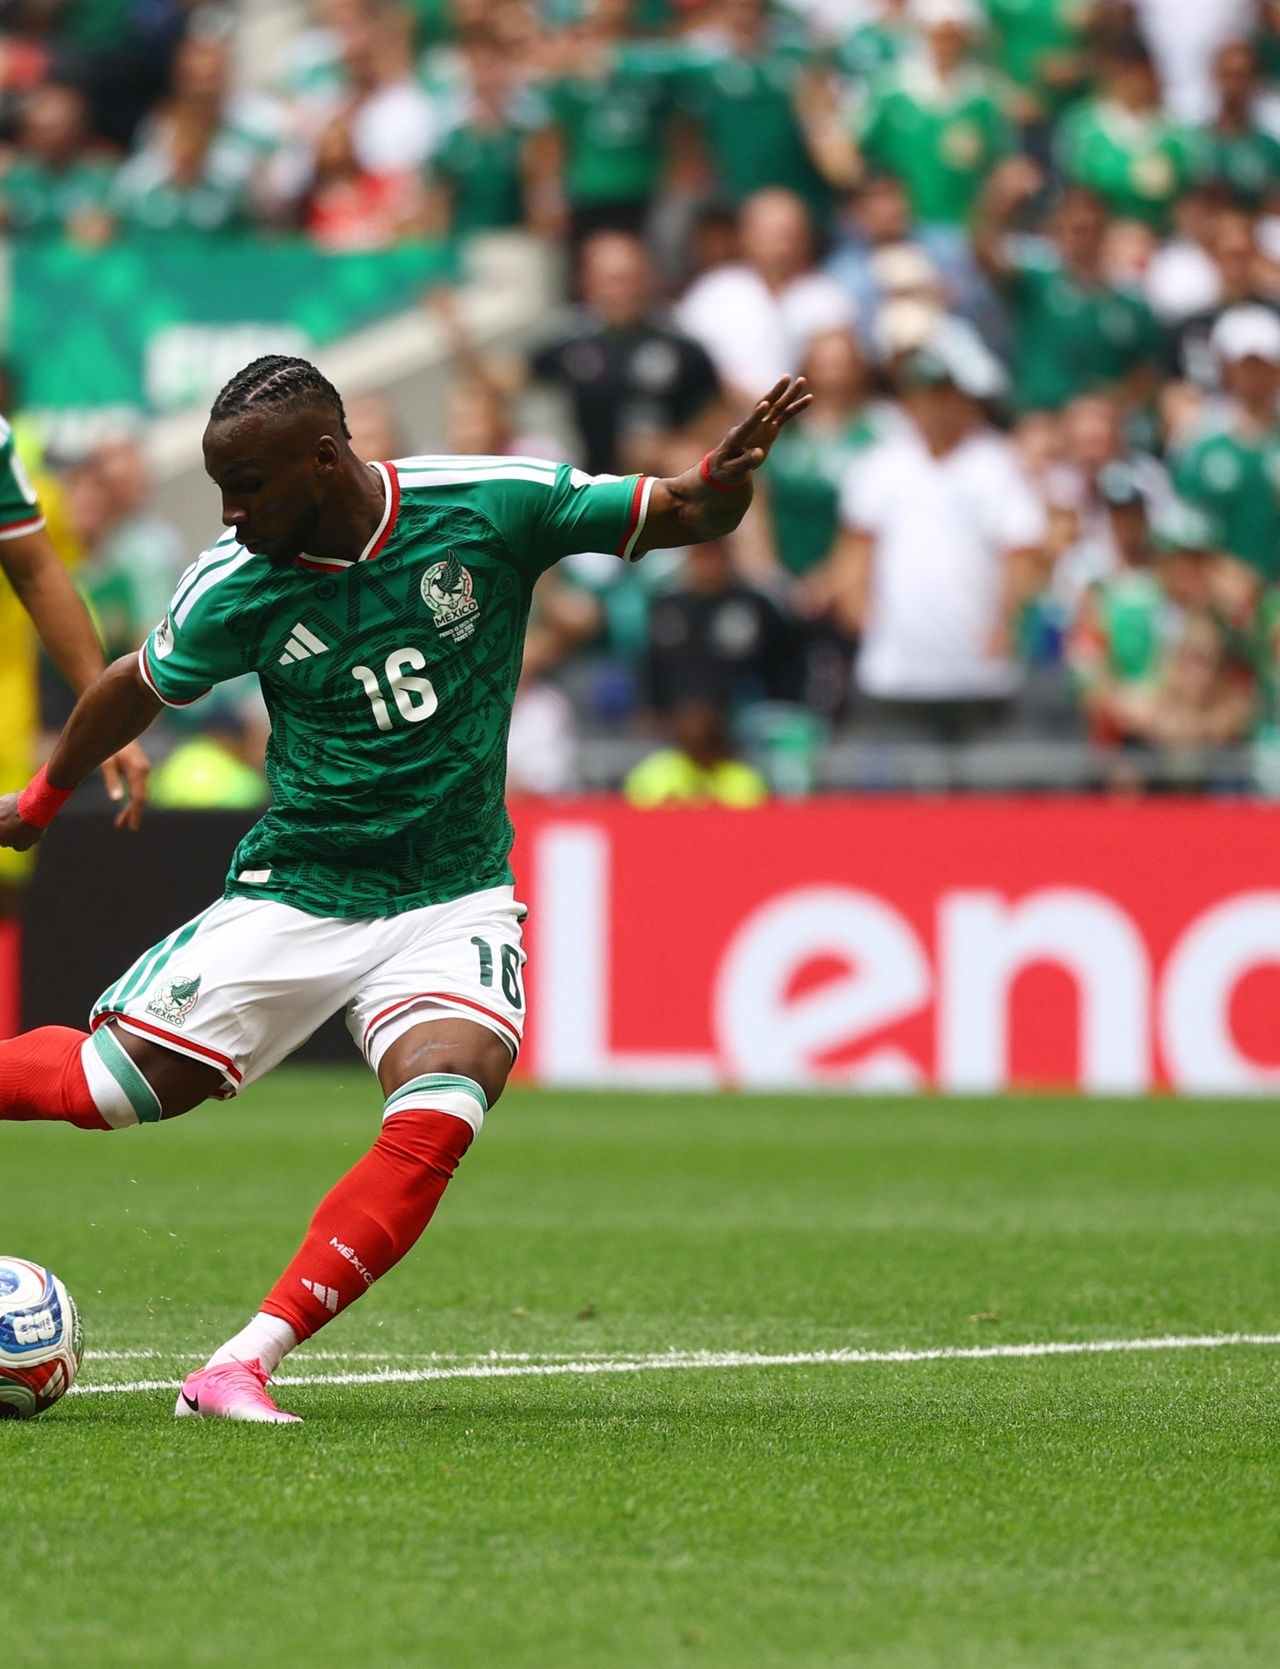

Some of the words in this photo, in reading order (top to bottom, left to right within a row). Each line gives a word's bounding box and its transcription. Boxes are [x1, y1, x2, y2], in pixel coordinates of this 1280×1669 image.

[434, 602, 477, 627] MÉXICO
[351, 647, 438, 731] 16
[470, 936, 522, 1010] 16
[147, 1004, 183, 1026] MÉXICO
